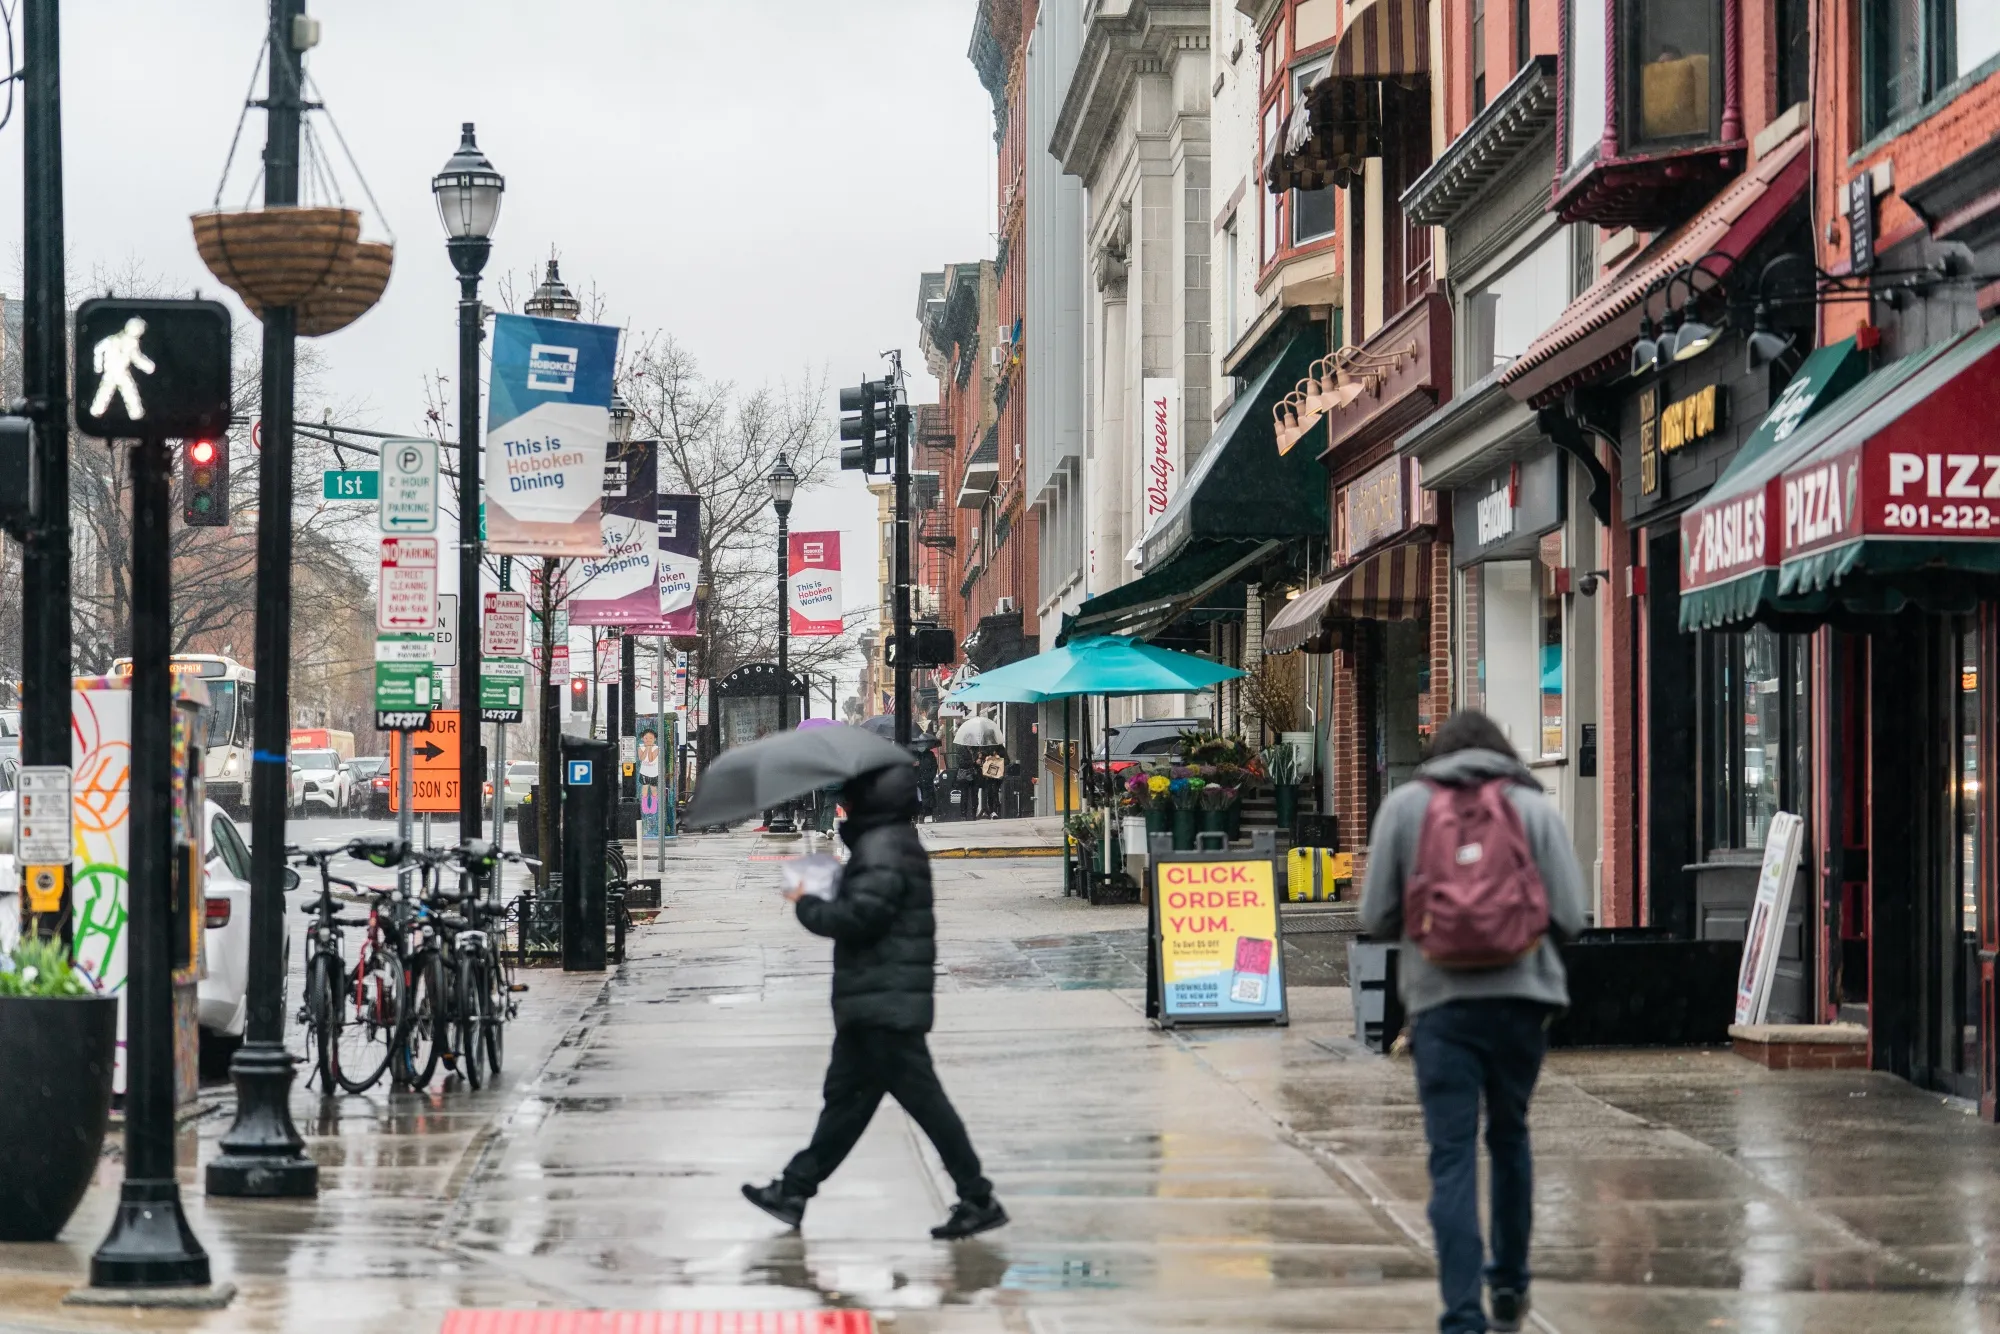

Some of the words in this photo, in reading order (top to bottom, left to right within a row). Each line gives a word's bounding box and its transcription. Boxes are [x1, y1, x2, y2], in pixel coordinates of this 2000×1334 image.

[460, 175, 470, 187] H
[529, 360, 577, 372] HOBOKEN
[504, 438, 542, 457] This
[545, 435, 562, 452] is
[404, 452, 416, 468] P
[1147, 396, 1175, 516] Walgreens
[507, 452, 584, 475] Hoboken
[336, 475, 363, 495] 1st
[389, 476, 396, 488] 2
[401, 476, 430, 487] HOUR
[510, 472, 564, 493] Dining
[401, 490, 417, 500] PAY
[388, 503, 430, 513] PARKING
[1785, 462, 1843, 550] PIZZA
[610, 531, 622, 544] is
[382, 543, 398, 561] NO
[400, 548, 436, 559] PARKING
[583, 554, 650, 578] Shopping
[662, 562, 671, 573] is
[394, 570, 424, 579] STREET
[390, 582, 428, 590] CLEANING
[796, 582, 814, 592] This
[814, 580, 822, 588] is
[798, 586, 833, 600] Hoboken
[392, 594, 426, 602] MON-FRI
[485, 597, 496, 610] NO
[497, 600, 524, 609] PARKING
[800, 594, 833, 606] Working
[600, 641, 608, 650] NO
[721, 665, 798, 689] HOBOKN
[378, 712, 427, 729] 147377
[482, 709, 518, 720] 147377
[574, 764, 588, 780] P
[396, 781, 440, 798] HDSON
[446, 781, 458, 798] ST
[1166, 866, 1255, 885] CLICK.
[1168, 890, 1266, 909] ORDER.
[1168, 916, 1236, 934] YUM.
[1174, 982, 1218, 991] DOWNLOAD
